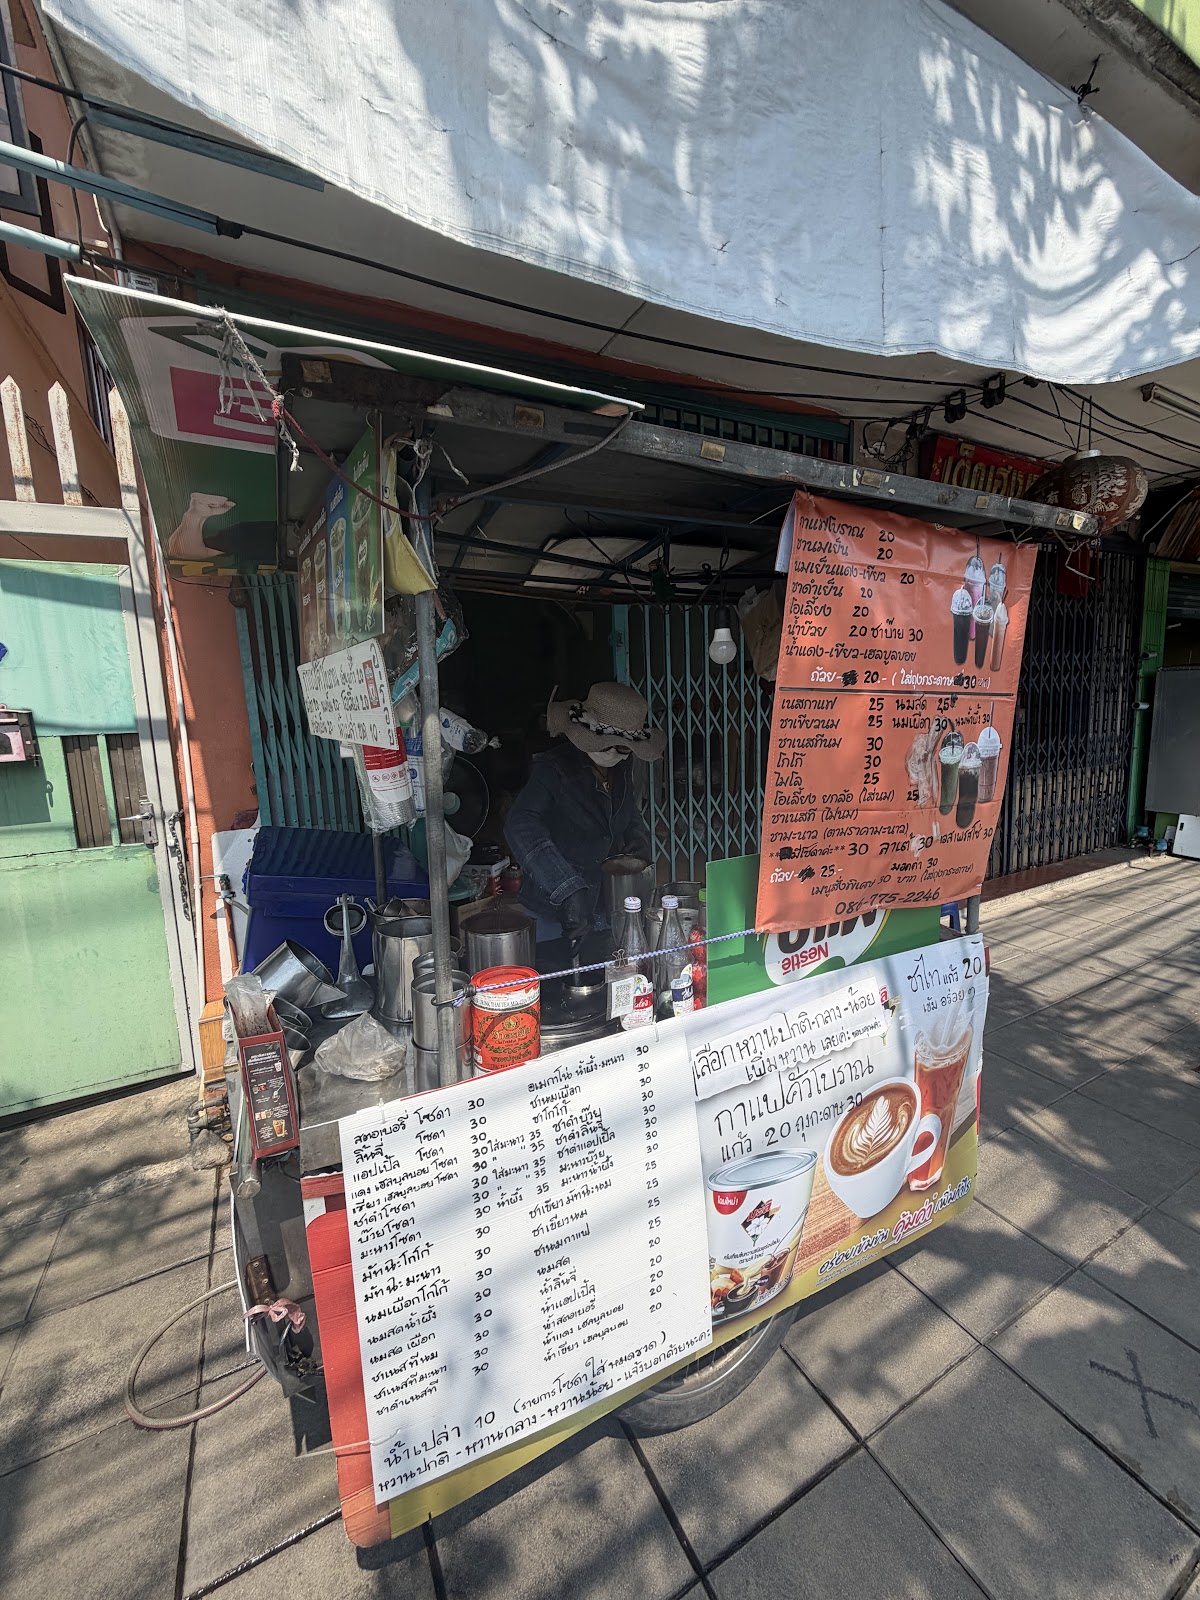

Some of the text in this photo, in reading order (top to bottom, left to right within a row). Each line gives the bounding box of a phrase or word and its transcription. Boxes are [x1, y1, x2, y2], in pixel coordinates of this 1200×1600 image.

[800, 515, 895, 543] กาแฟโบราณ 20
[796, 537, 893, 560] ชานมเย็น 20
[792, 578, 873, 598] ชาดำเย็น 20
[900, 572, 915, 585] 20
[852, 606, 869, 617] 20
[787, 616, 923, 642] น้ำบ๊วย 20 30
[963, 675, 976, 689] 30
[781, 694, 927, 710] เนสกาแฟ 25 นมสด
[780, 714, 840, 729] ชาเขียวนม
[868, 715, 883, 728] 25
[935, 718, 948, 731] 30
[982, 713, 990, 724] 30
[866, 737, 883, 751] 30
[864, 755, 881, 770] 30
[774, 771, 880, 787] ไมโล 25
[774, 788, 816, 805] โอเลี้ยง
[822, 789, 854, 804] ยกล้อ
[907, 790, 919, 802] 25
[770, 829, 818, 842] ชามะนาว
[848, 842, 868, 856] 30
[917, 836, 933, 851] 30
[983, 827, 994, 838] 30
[926, 857, 938, 868] 30
[878, 875, 891, 884] 30
[835, 887, 939, 915] 086-775-2246
[943, 957, 982, 985] แก้ว 20
[923, 990, 965, 1013] เข้ม อร่อย
[413, 1106, 451, 1125] โซดา
[468, 1098, 485, 1110] 30
[636, 1045, 649, 1056] 30
[415, 1129, 446, 1144] โซดา
[470, 1116, 487, 1129] 30
[637, 1062, 650, 1072] 30
[353, 1154, 400, 1182] แอปเปิ้ล
[415, 1146, 444, 1162] โซดา
[470, 1132, 487, 1144] 30
[639, 1076, 652, 1087] 30
[722, 1131, 752, 1162] แก้ว
[765, 1122, 791, 1147] 20
[846, 1092, 863, 1112] 30
[351, 1187, 371, 1200] แดง
[431, 1156, 458, 1170] โซดา
[472, 1146, 488, 1158] 30
[529, 1129, 541, 1141] 35
[641, 1090, 654, 1101] 30
[434, 1171, 459, 1185] โซดา
[472, 1160, 487, 1172] 30
[530, 1140, 545, 1153] 35
[643, 1104, 656, 1115] 30
[472, 1175, 488, 1189] 30
[533, 1156, 546, 1168] 35
[644, 1116, 658, 1128] 30
[472, 1190, 489, 1203] 30
[535, 1167, 546, 1179] 35
[645, 1130, 658, 1141] 30
[360, 1231, 421, 1260] มะนาวโซดา
[475, 1205, 491, 1218] 30
[496, 1187, 523, 1208] น้ำผึ้ง
[536, 1182, 549, 1195] 35
[646, 1142, 659, 1154] 30
[475, 1160, 657, 1238] 30 25
[475, 1177, 659, 1260] 30 ชาเขียวนม 25
[475, 1267, 492, 1281] 30
[534, 1222, 591, 1257] ชานมกาแฟ
[647, 1196, 660, 1209] 25
[474, 1288, 491, 1302] 30
[537, 1255, 571, 1276] นมสด
[648, 1216, 662, 1230] 25
[474, 1309, 492, 1323] 30
[649, 1237, 661, 1248] 20
[474, 1330, 489, 1342] 30
[650, 1254, 663, 1267] 20
[649, 1302, 662, 1314] 20
[474, 1347, 488, 1359] 30
[650, 1270, 663, 1283] 20
[472, 1362, 489, 1376] 30
[650, 1285, 663, 1296] 20
[383, 1411, 496, 1468] น้ำเปล่า 10
